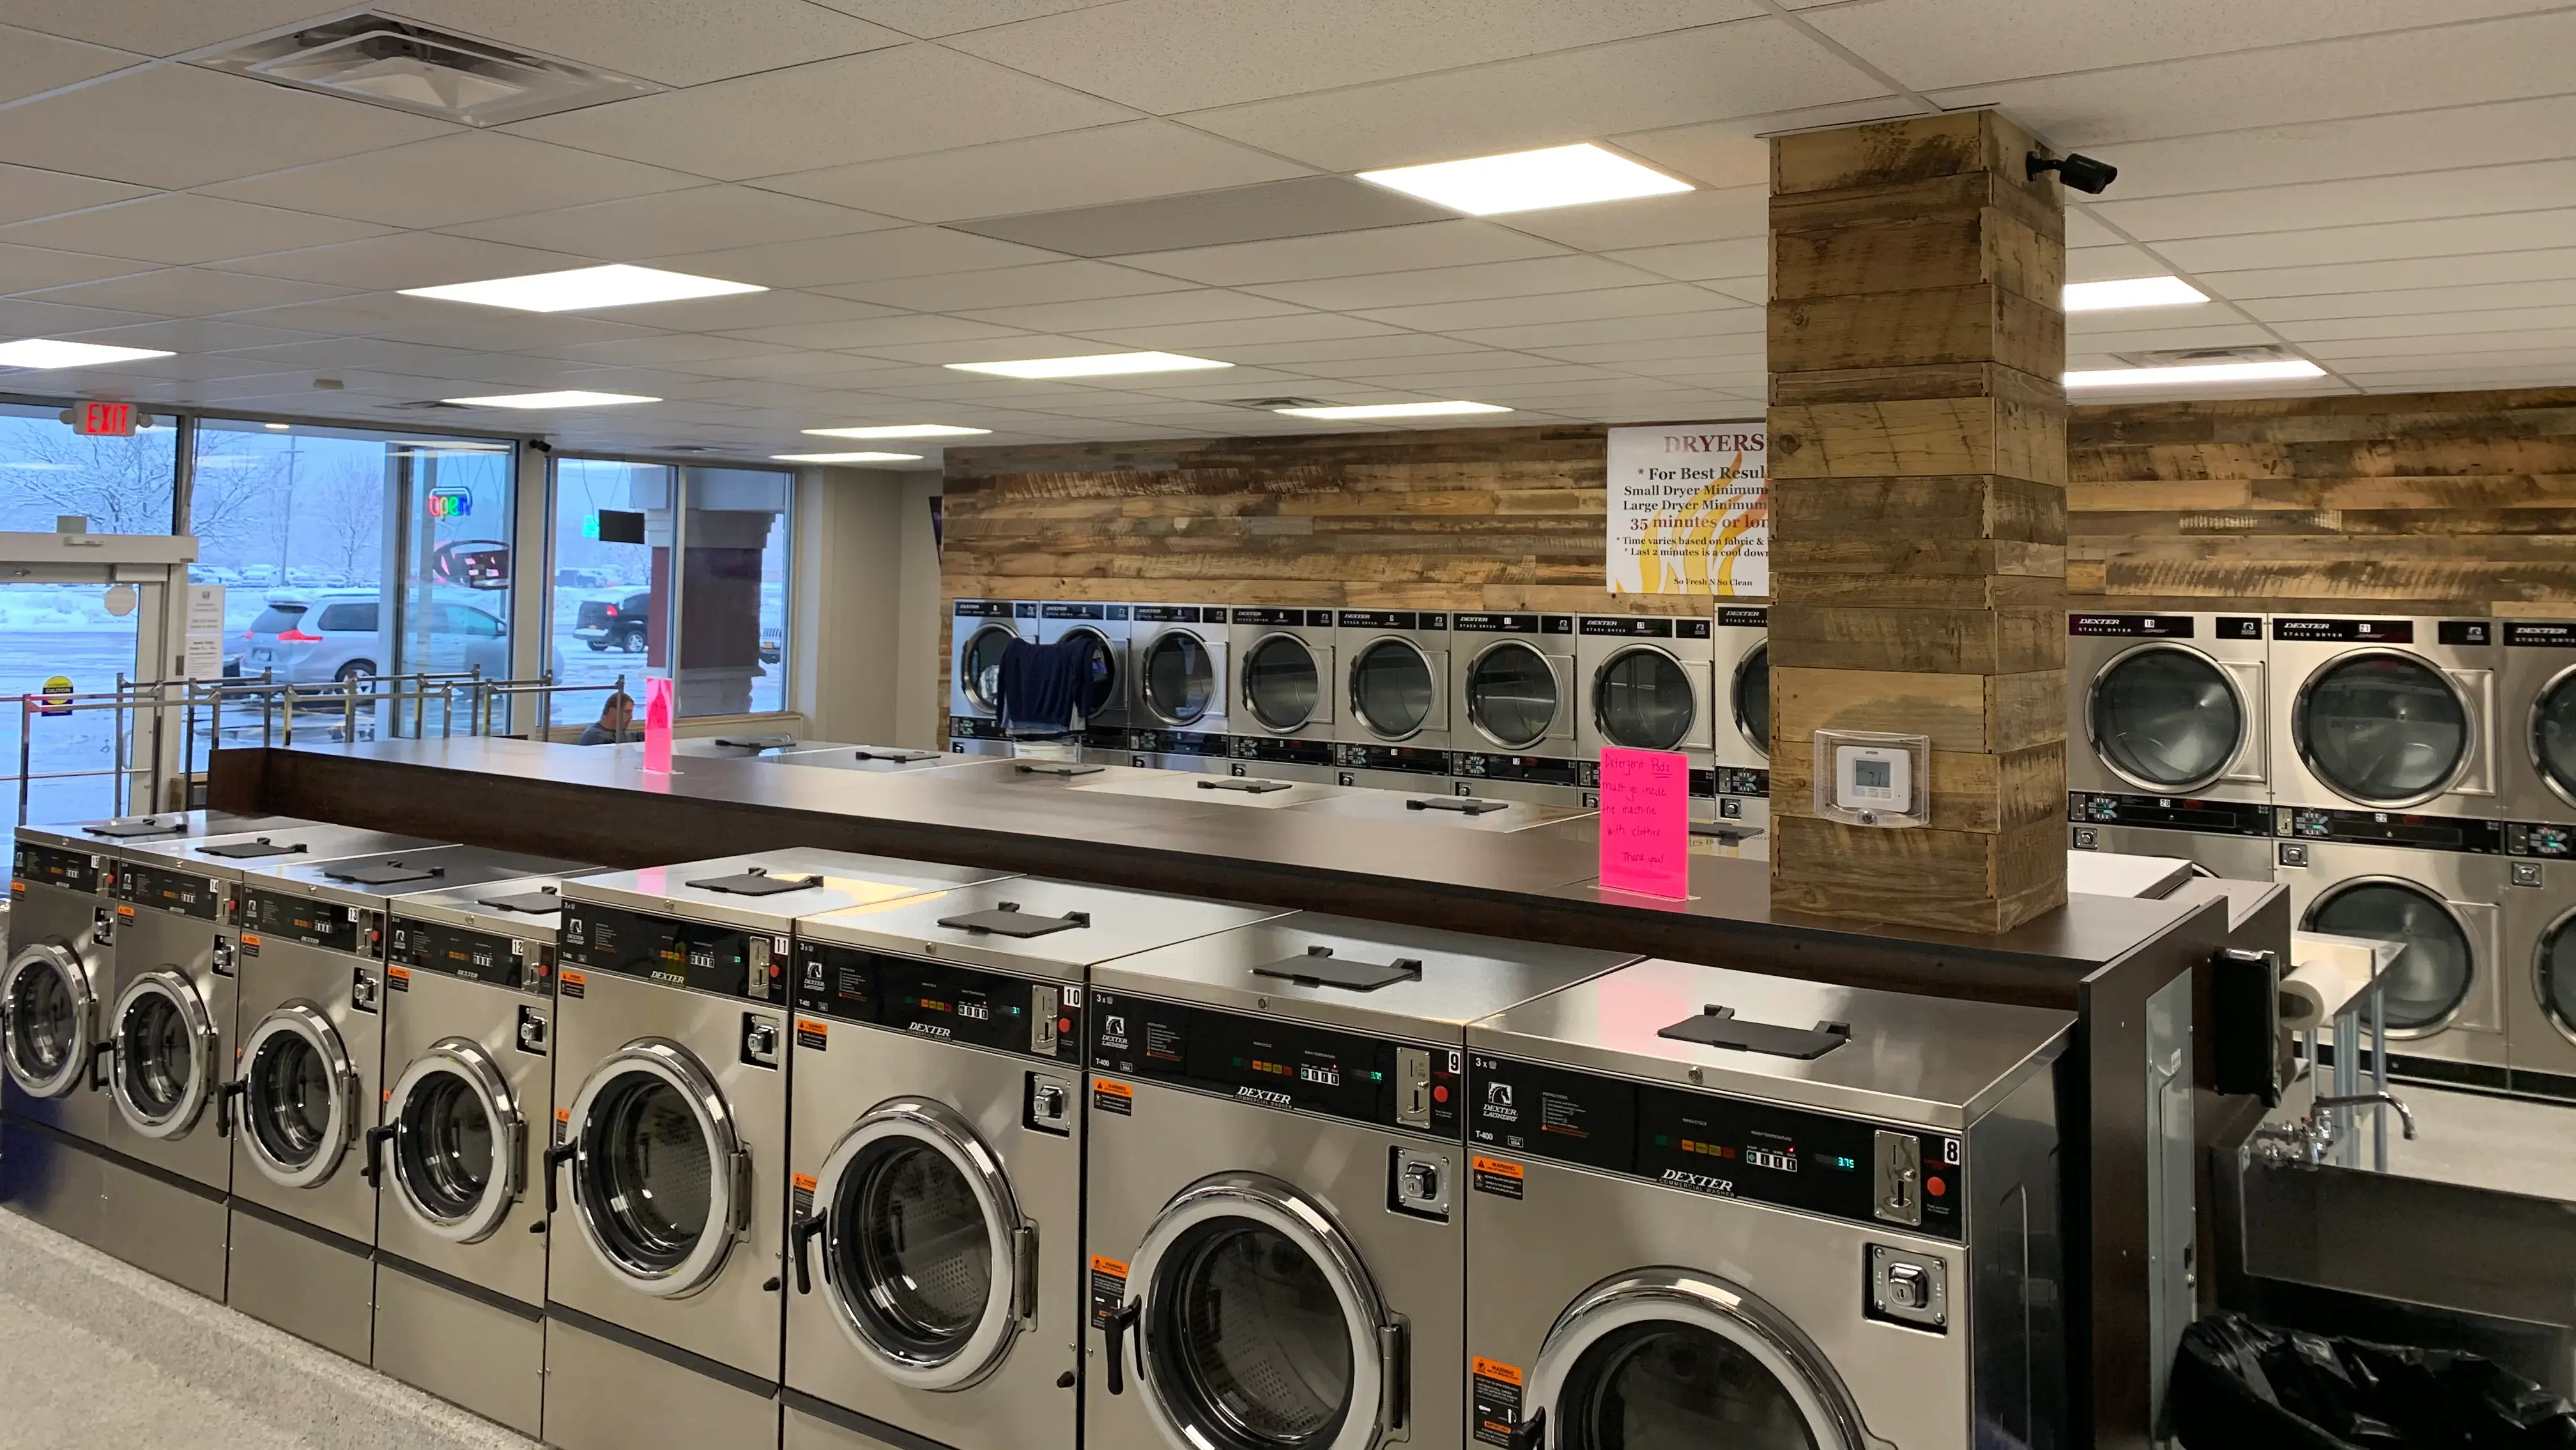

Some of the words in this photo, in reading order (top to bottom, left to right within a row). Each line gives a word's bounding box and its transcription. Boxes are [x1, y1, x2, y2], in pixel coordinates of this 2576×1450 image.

[87, 403, 130, 435] EXIT
[1664, 433, 1765, 452] DRYERS
[1648, 468, 1676, 480] For
[1680, 467, 1715, 480] Best
[1720, 465, 1767, 479] Resul
[1624, 485, 1659, 497] Small
[1663, 486, 1700, 498] Dryer
[1703, 484, 1768, 495] Minimum
[1623, 500, 1659, 513] Large
[1661, 500, 1699, 513] Dryer
[1630, 518, 1648, 530] 35
[1652, 515, 1717, 528] minutes
[1721, 518, 1740, 528] or
[1678, 537, 1707, 545] based
[1724, 537, 1754, 546] fabric
[1721, 548, 1742, 557] cool
[1605, 753, 1644, 776] Detergent
[1651, 758, 1670, 772] Pods
[1602, 781, 1625, 791] must
[1602, 803, 1615, 814] the
[1623, 806, 1657, 815] machine
[1632, 827, 1660, 837] clothes
[1622, 851, 1646, 861] Thank
[350, 909, 358, 920] 13
[514, 941, 523, 953] 12
[777, 939, 786, 953] 11
[650, 970, 684, 984] DEXTER
[1066, 989, 1080, 1005] 10
[908, 1021, 951, 1037] DEXTER
[1101, 1034, 1128, 1044] DEXTER
[1101, 1040, 1129, 1049] LAUNDRY
[1096, 1058, 1110, 1067] T-400
[1450, 1053, 1459, 1071] 9
[1475, 1057, 1482, 1067] 3
[1237, 1086, 1291, 1105] DEXTER
[1483, 1104, 1518, 1116] DEXTER
[1482, 1111, 1518, 1122] LAUNDRY
[1476, 1130, 1494, 1141] T-400
[1947, 1141, 1958, 1162] 8
[1838, 1157, 1854, 1168] 3.75
[1661, 1168, 1733, 1191] DEXTER
[1659, 1178, 1703, 1192] COMMERCIAL
[1706, 1187, 1735, 1198] WASHER
